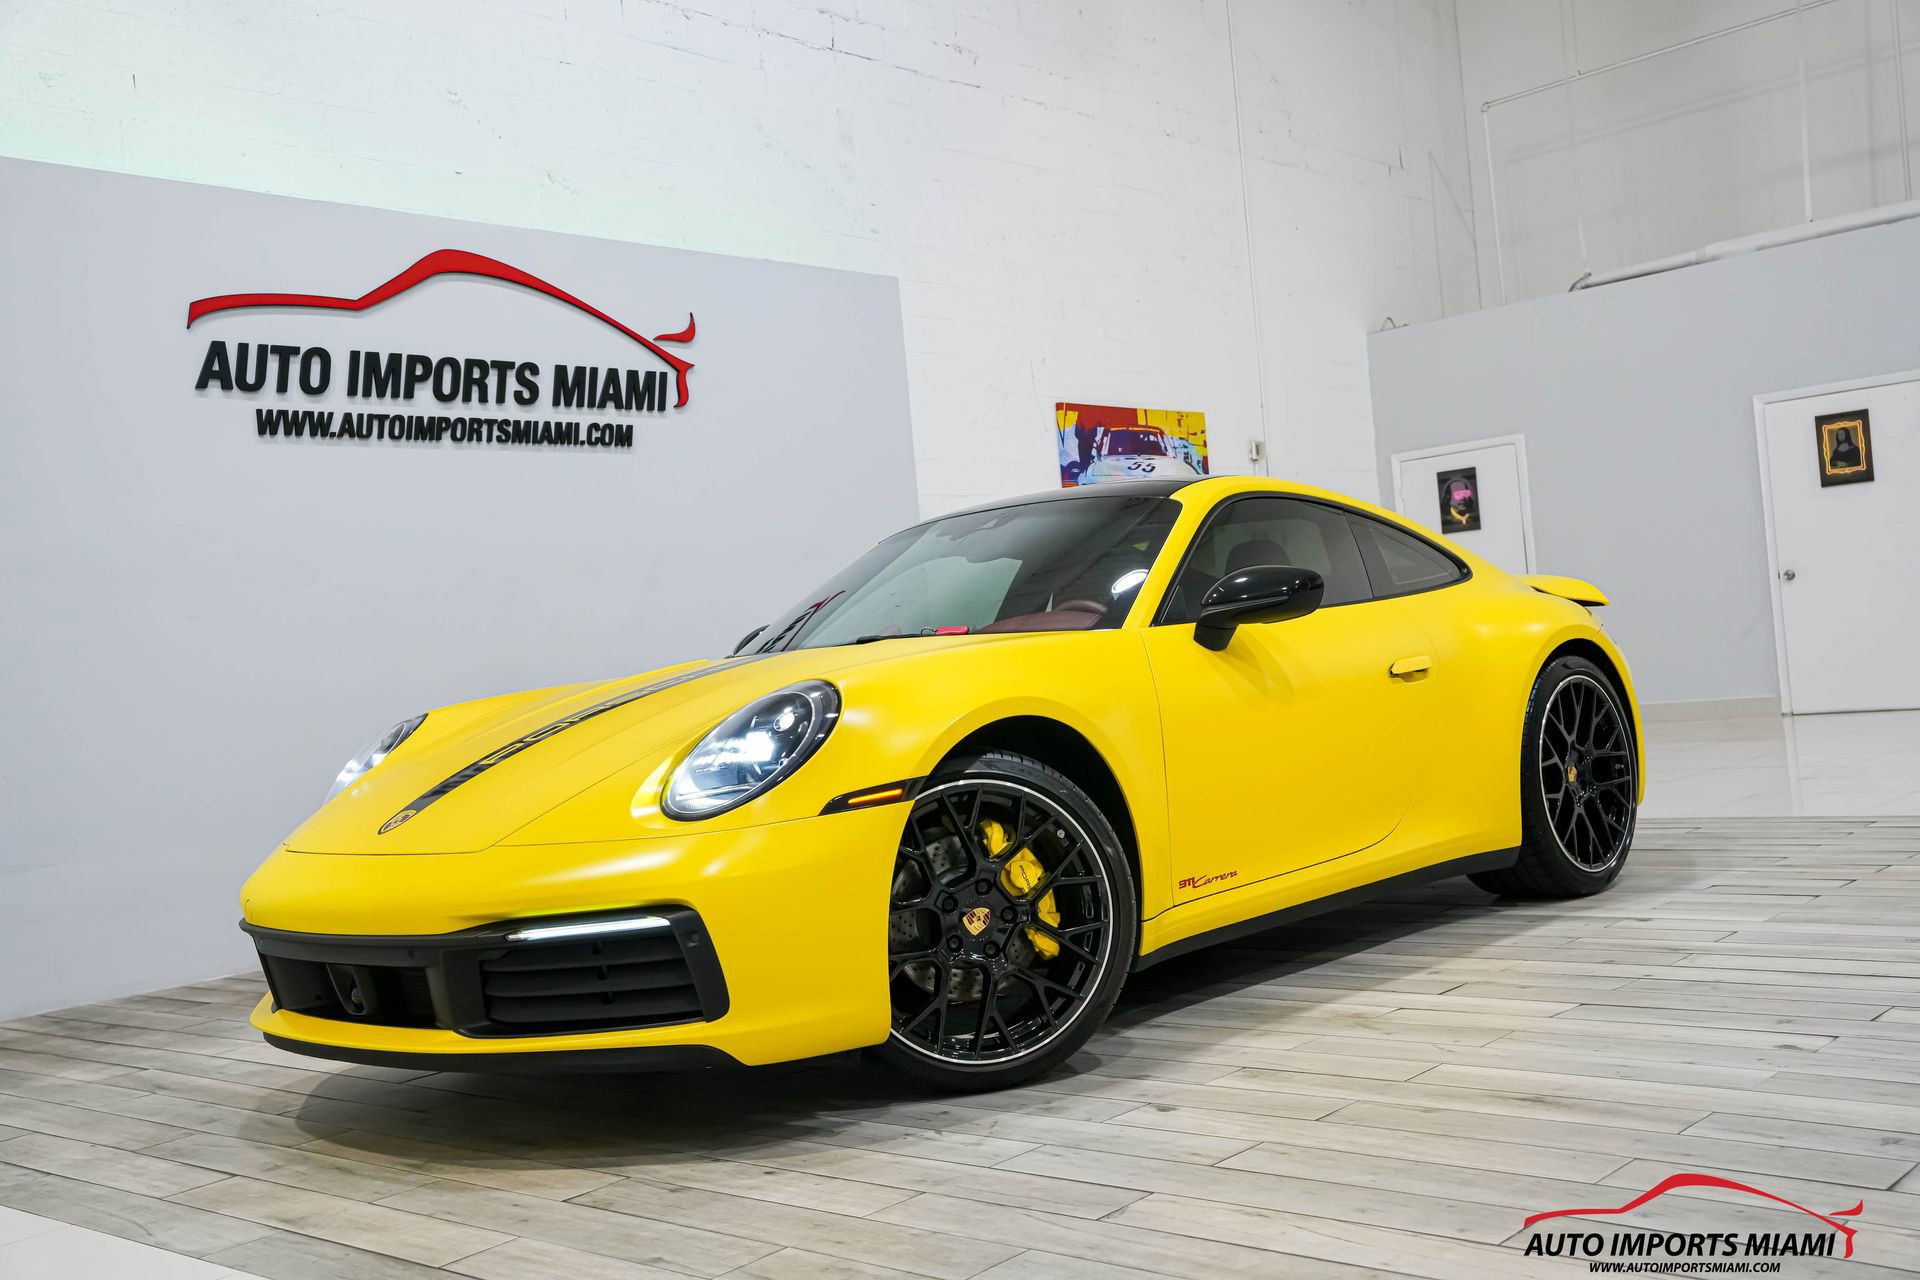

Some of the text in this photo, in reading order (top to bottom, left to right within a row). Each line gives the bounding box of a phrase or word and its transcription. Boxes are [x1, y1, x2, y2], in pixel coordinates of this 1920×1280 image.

[194, 340, 668, 413] AUTO IMPORTS MIAMI
[256, 408, 634, 448] WWW.AUTOIMPORTSMIAMI.COM
[1127, 461, 1156, 473] 55
